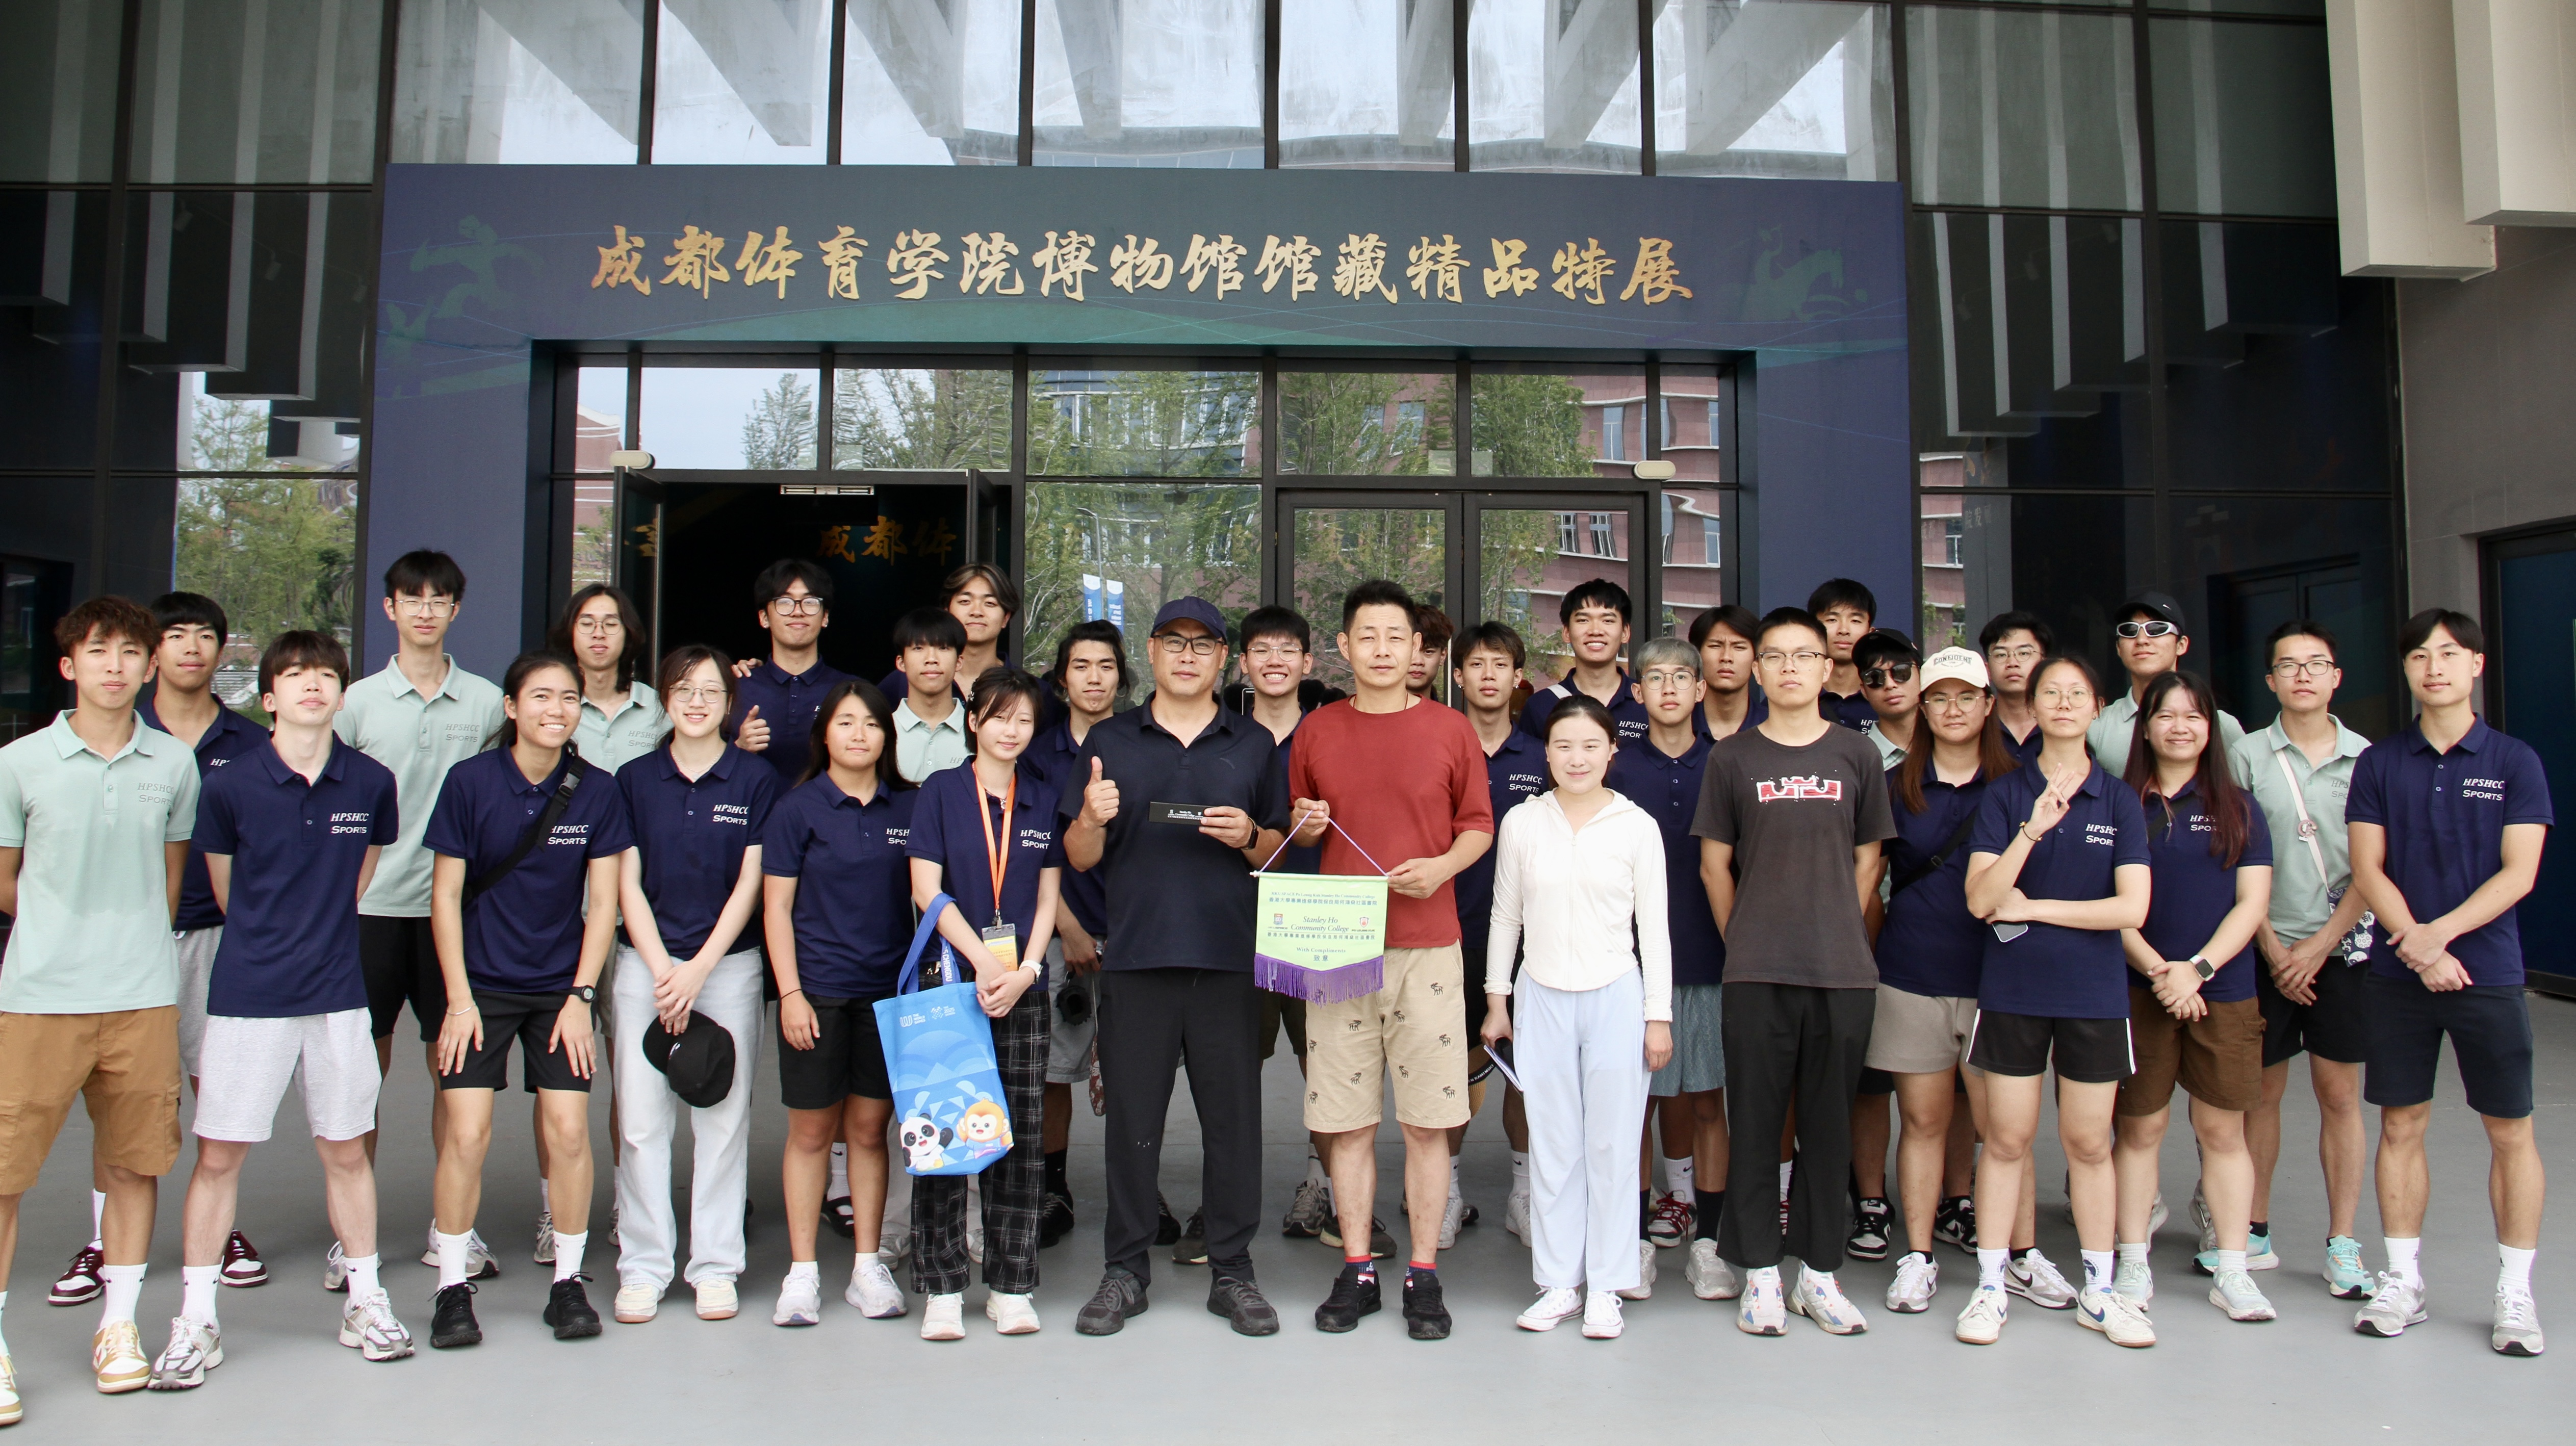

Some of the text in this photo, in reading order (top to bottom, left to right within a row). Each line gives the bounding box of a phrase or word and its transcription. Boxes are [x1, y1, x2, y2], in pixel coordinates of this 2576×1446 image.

[591, 225, 1693, 304] 成都体育学院博物馆馆藏精品特展
[1934, 655, 1972, 666] CONFIDENT
[445, 724, 480, 732] HPSHCC
[628, 730, 655, 740] HPSHC
[1618, 730, 1641, 739] SPOR
[1509, 774, 1543, 784] HPSHCC
[2331, 780, 2350, 788] HPS
[2462, 778, 2505, 789] HPSHCC
[2332, 791, 2348, 799] SPO
[2462, 789, 2503, 801] SPORTS
[713, 804, 749, 814] HPSHCC
[330, 813, 370, 822] HPSHCC
[712, 814, 748, 825] SPORTS
[886, 828, 910, 836] HPSH
[548, 837, 587, 845] SPORTS
[888, 837, 907, 845] SPO
[1022, 839, 1049, 849] SPORT
[1303, 916, 1326, 925] Stanley
[1291, 923, 1349, 933] Community College
